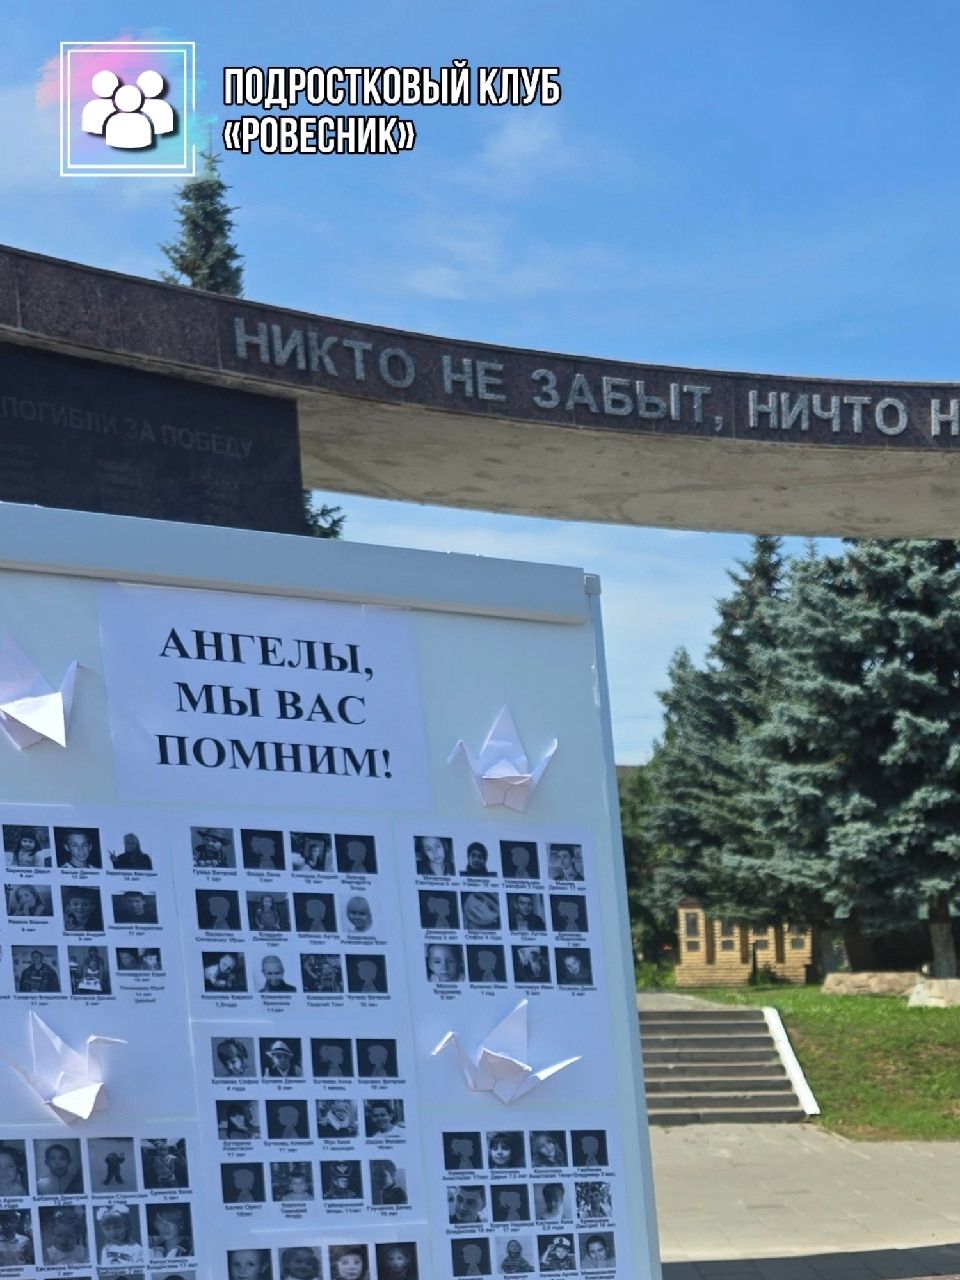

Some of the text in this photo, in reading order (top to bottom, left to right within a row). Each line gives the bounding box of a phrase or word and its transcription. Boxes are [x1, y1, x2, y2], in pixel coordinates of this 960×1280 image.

[233, 317, 416, 389] НИКТО
[442, 356, 507, 402] НЕ
[531, 367, 724, 432] ЗАБЫТ,
[747, 389, 909, 436] НИЧТО
[124, 417, 157, 444] ЗА
[159, 627, 374, 682] АНГЕЛЫ,
[176, 681, 367, 726] МЫ ВАС
[156, 733, 394, 780] ПОМНИМ!
